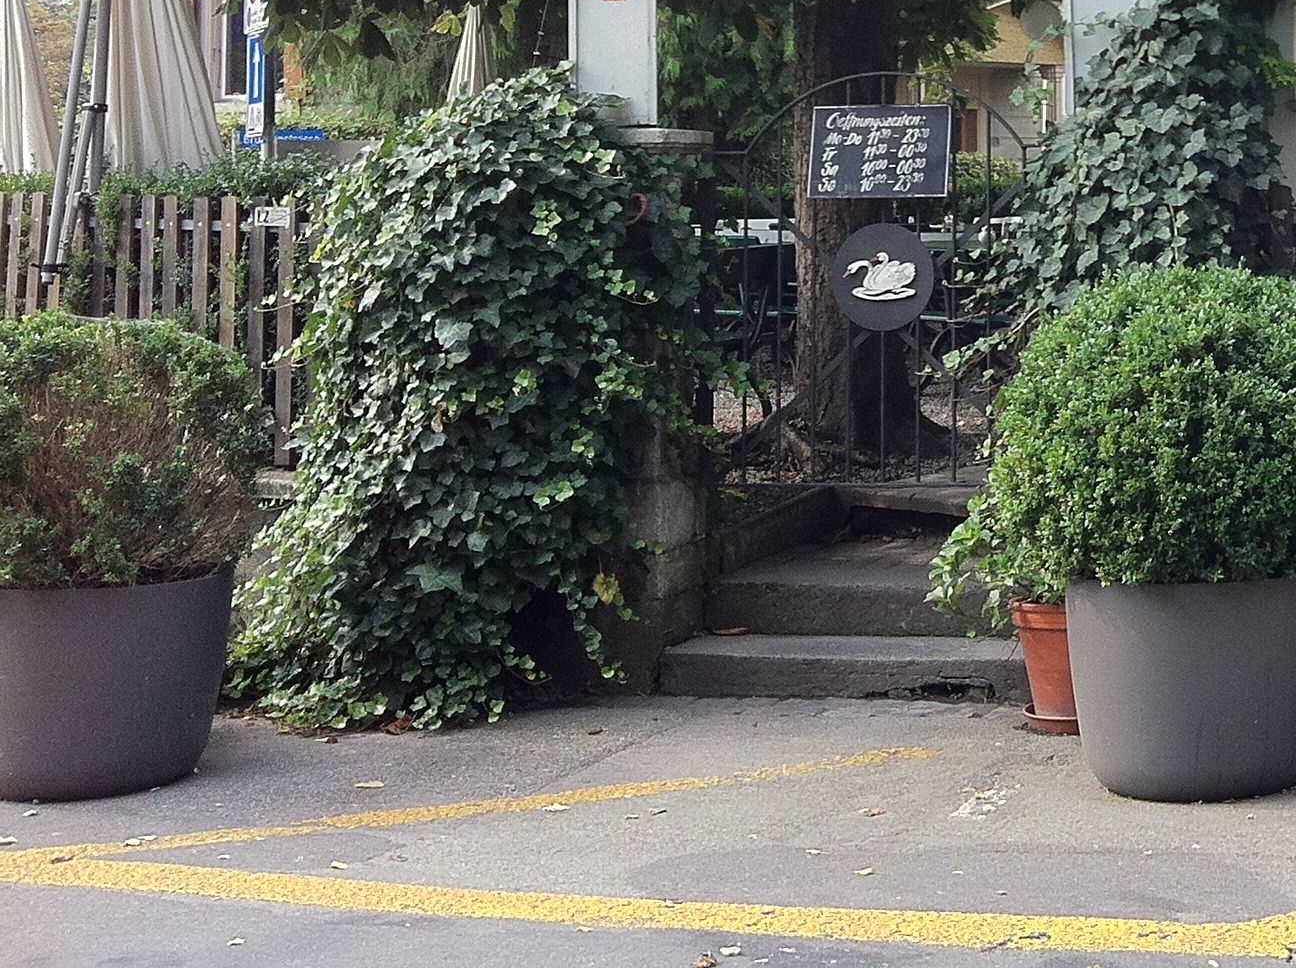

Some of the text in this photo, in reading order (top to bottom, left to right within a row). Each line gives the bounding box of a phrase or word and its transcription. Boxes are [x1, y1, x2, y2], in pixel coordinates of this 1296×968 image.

[821, 146, 838, 161] Fr
[820, 162, 839, 177] Sa
[817, 177, 837, 192] So
